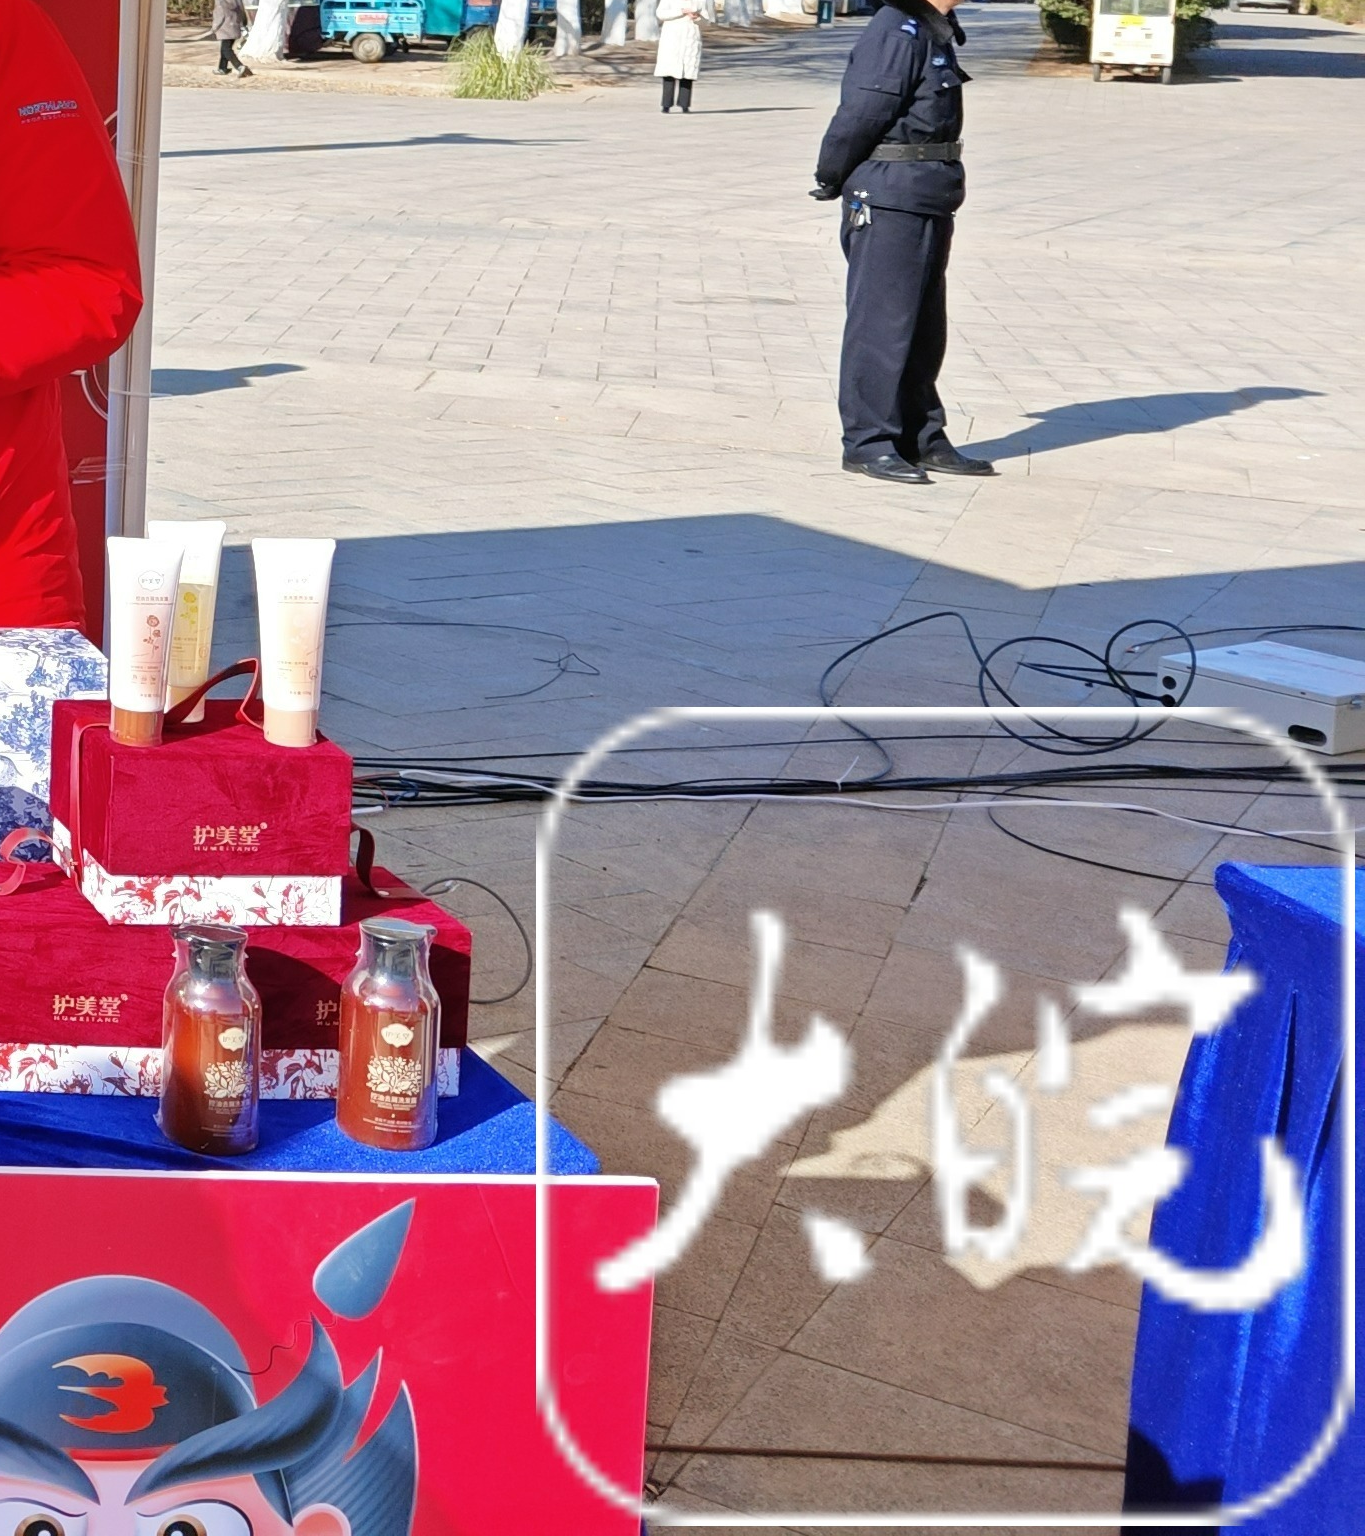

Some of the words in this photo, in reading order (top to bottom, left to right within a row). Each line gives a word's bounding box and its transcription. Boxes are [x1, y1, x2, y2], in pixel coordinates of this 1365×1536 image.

[192, 824, 261, 846] 护美堂
[52, 994, 122, 1017] 护美堂
